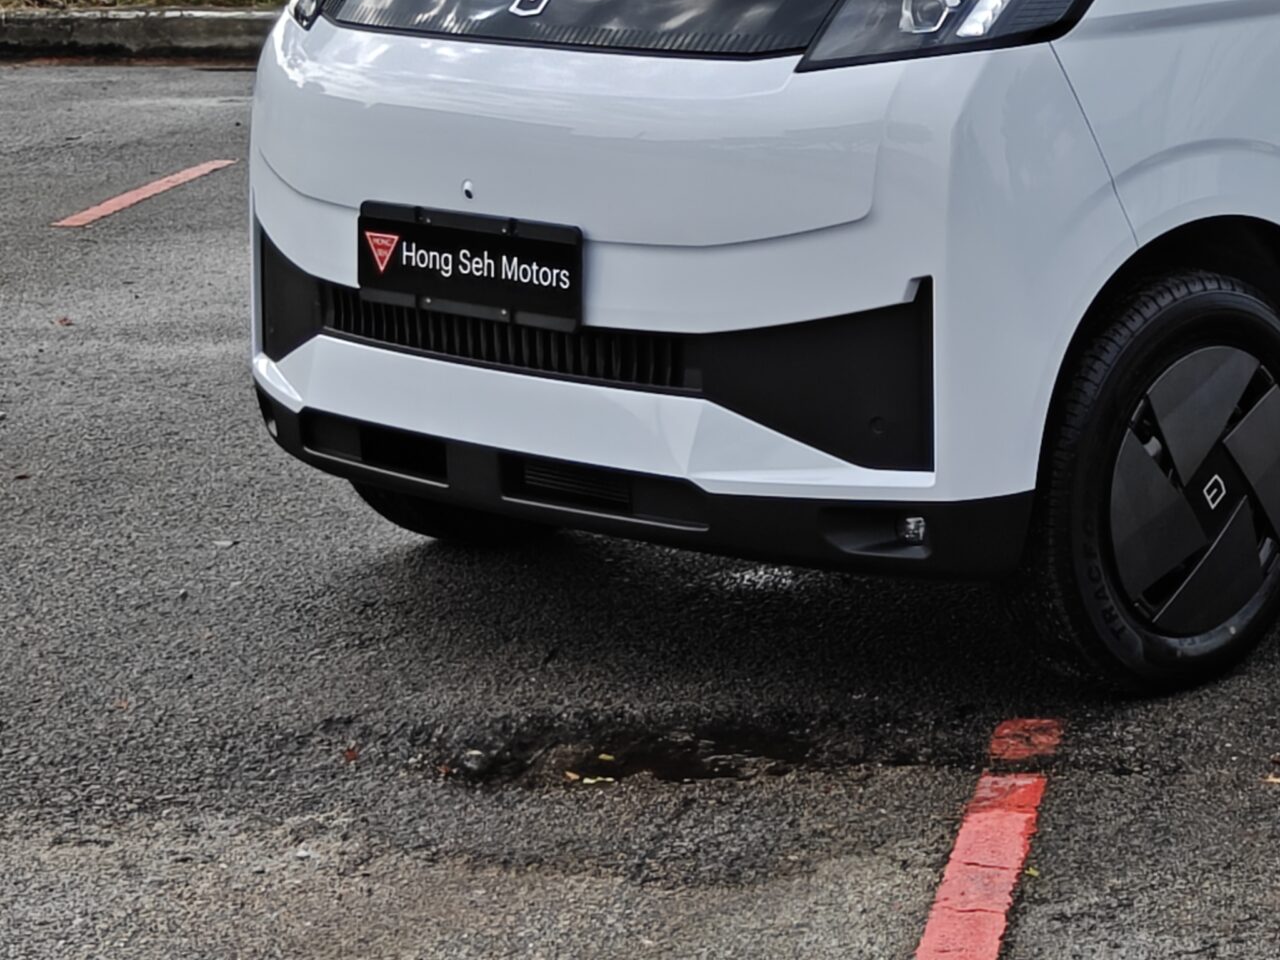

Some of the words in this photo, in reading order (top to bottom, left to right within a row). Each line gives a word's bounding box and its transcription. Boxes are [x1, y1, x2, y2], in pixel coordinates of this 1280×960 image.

[402, 241, 453, 278] Hong
[458, 249, 495, 277] Seh
[501, 254, 571, 289] Motors
